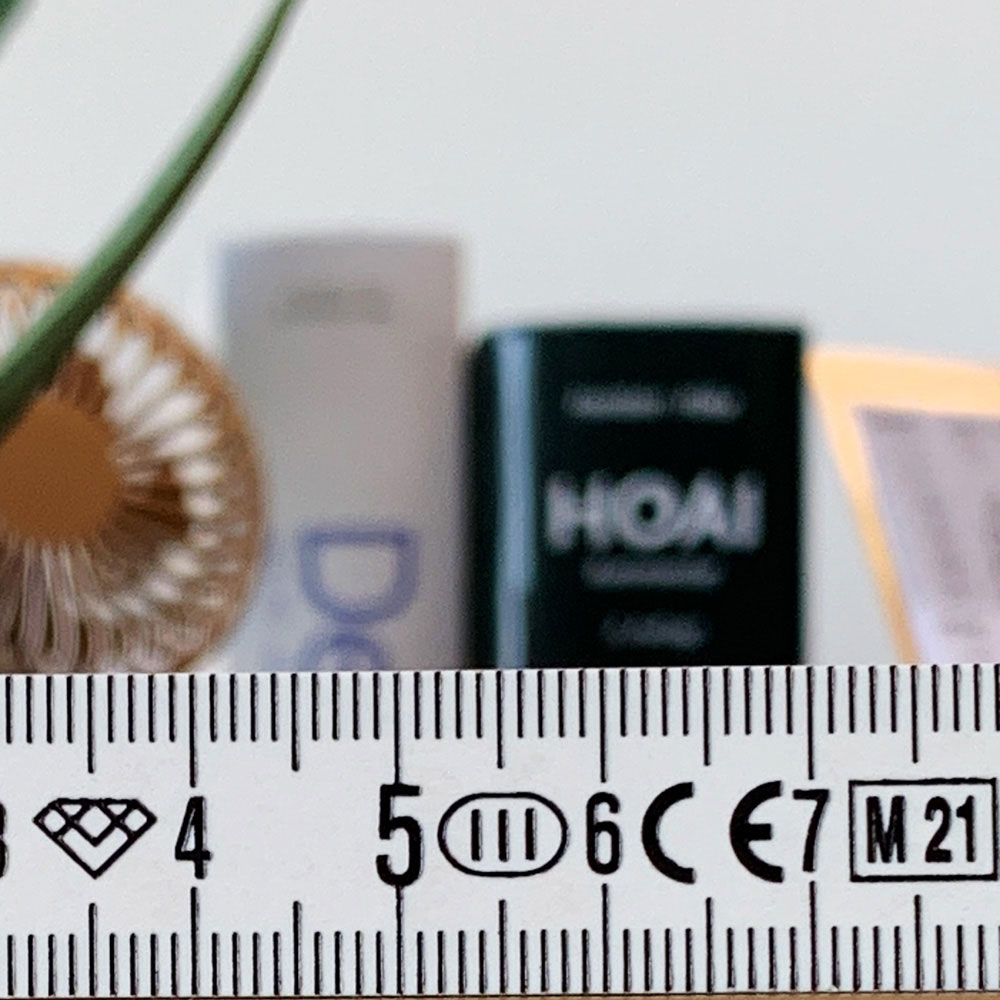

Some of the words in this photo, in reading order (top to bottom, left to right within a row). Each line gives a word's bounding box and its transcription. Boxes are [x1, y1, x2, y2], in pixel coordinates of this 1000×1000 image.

[174, 795, 213, 880] 4
[375, 784, 424, 887] 5
[585, 791, 623, 876] 6
[792, 788, 831, 873] 7
